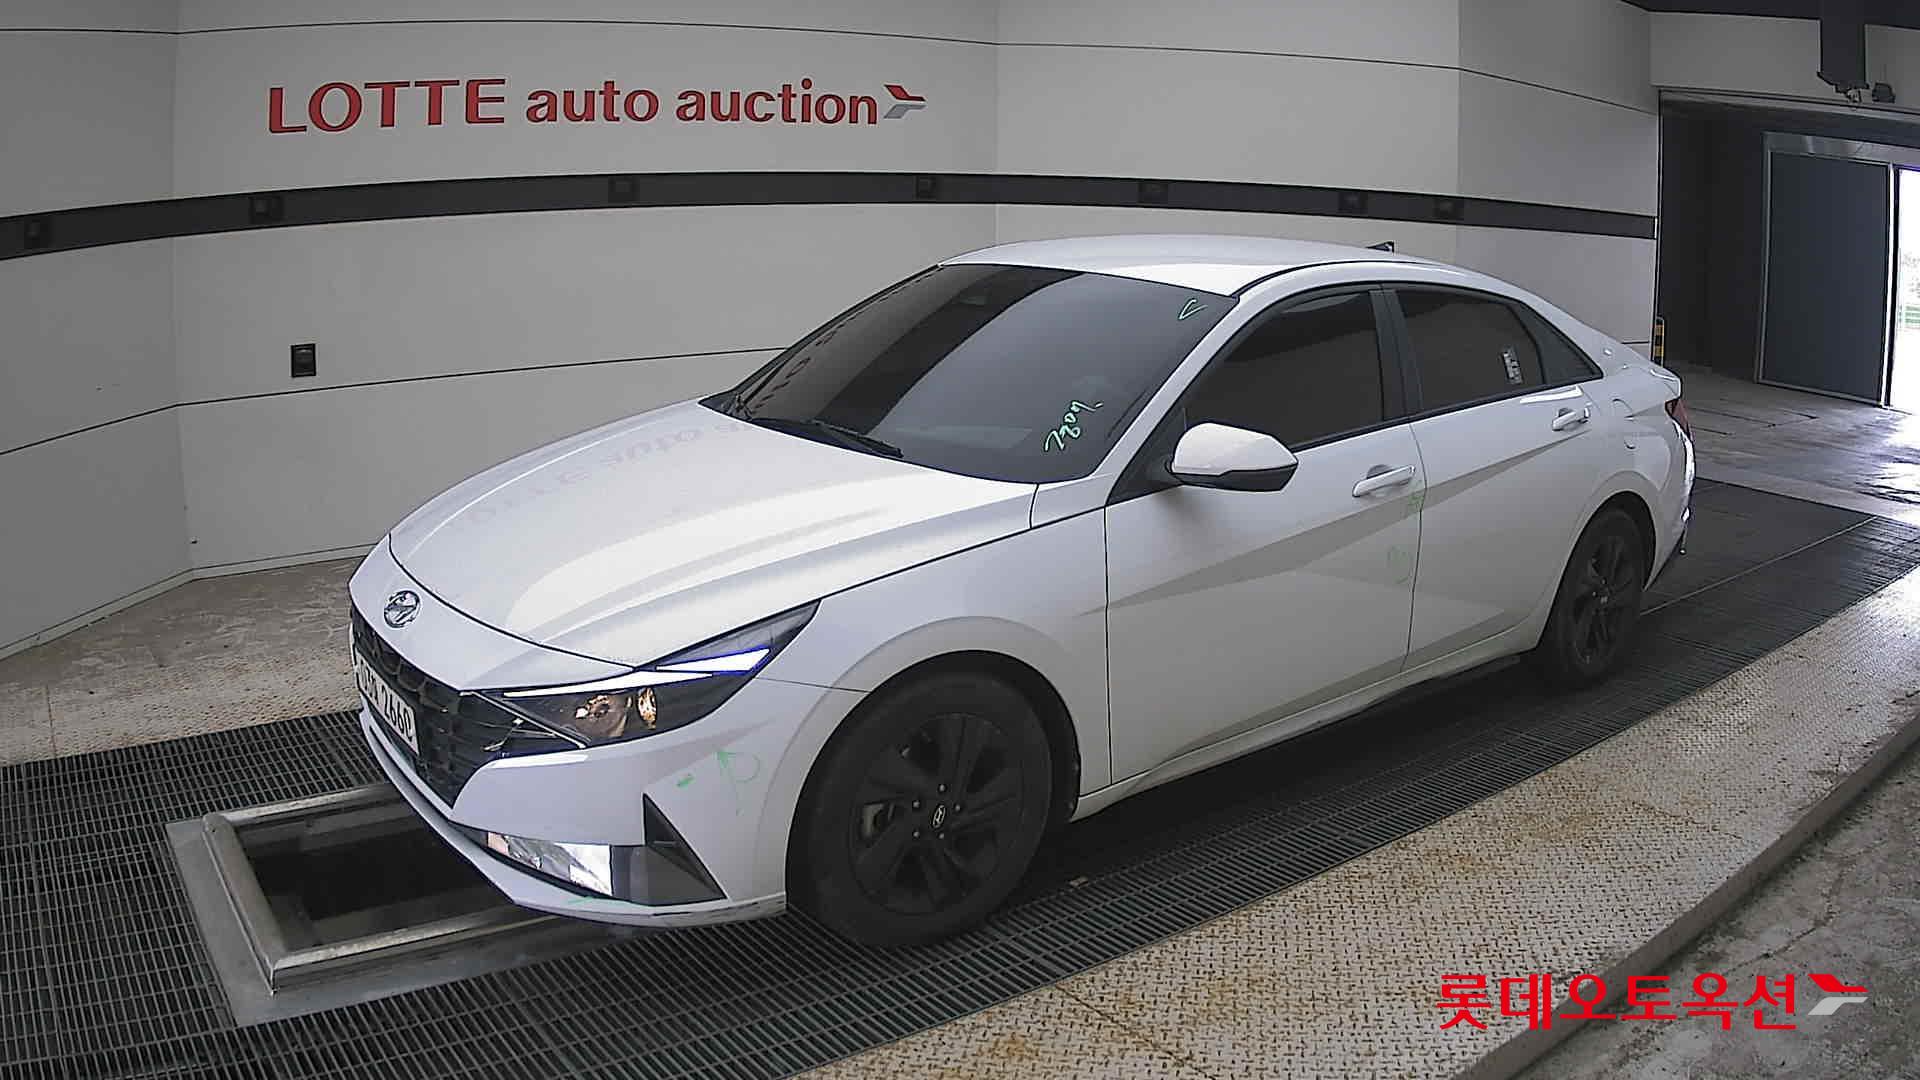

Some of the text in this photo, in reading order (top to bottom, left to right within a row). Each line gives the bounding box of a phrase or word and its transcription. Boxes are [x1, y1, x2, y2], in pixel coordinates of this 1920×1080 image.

[269, 79, 878, 133] LOTTE auto auction
